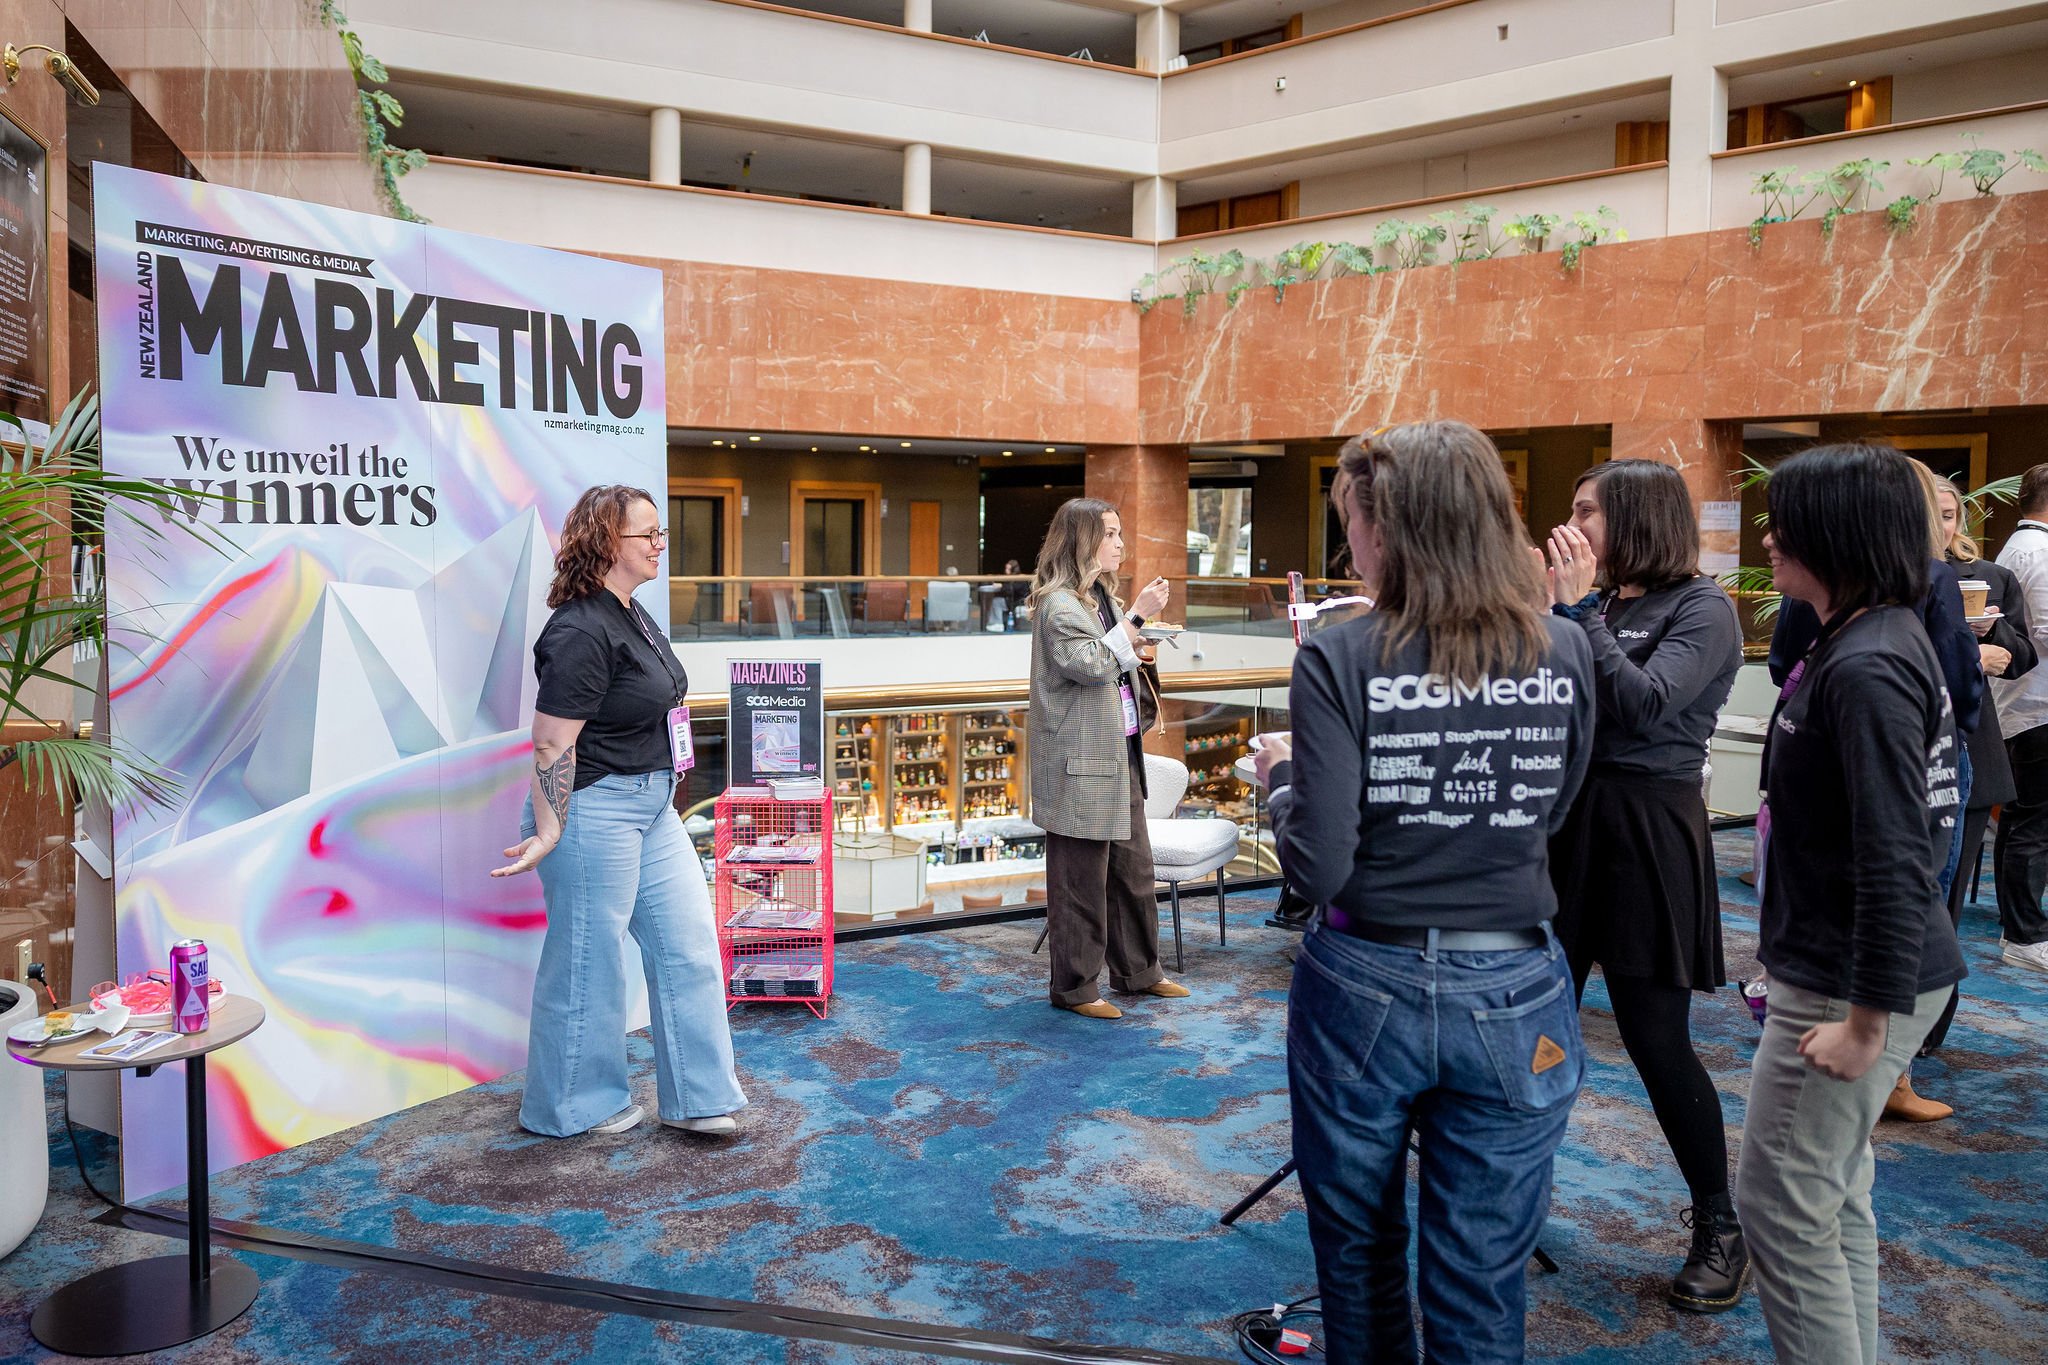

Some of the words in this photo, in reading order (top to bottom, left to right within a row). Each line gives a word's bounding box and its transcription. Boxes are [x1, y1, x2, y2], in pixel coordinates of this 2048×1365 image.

[144, 226, 227, 253] MARKETING,
[229, 241, 310, 265] ADVERTISING
[312, 254, 322, 267] &
[323, 256, 361, 272] MEDIA
[156, 253, 643, 419] MARKETING
[544, 419, 645, 436] nzmarketingmag.co.nz
[172, 435, 236, 472] We
[244, 442, 350, 476] unveil
[357, 444, 408, 478] the
[142, 477, 438, 527] winners
[731, 662, 806, 685] MAGAZINES
[755, 715, 797, 724] MARKETING
[1369, 731, 1440, 749] MARKETING
[1370, 754, 1422, 768] AGENCY
[1369, 766, 1436, 780] DIRECTORY
[1443, 780, 1498, 791] BLACK
[1443, 791, 1497, 803] WHITE
